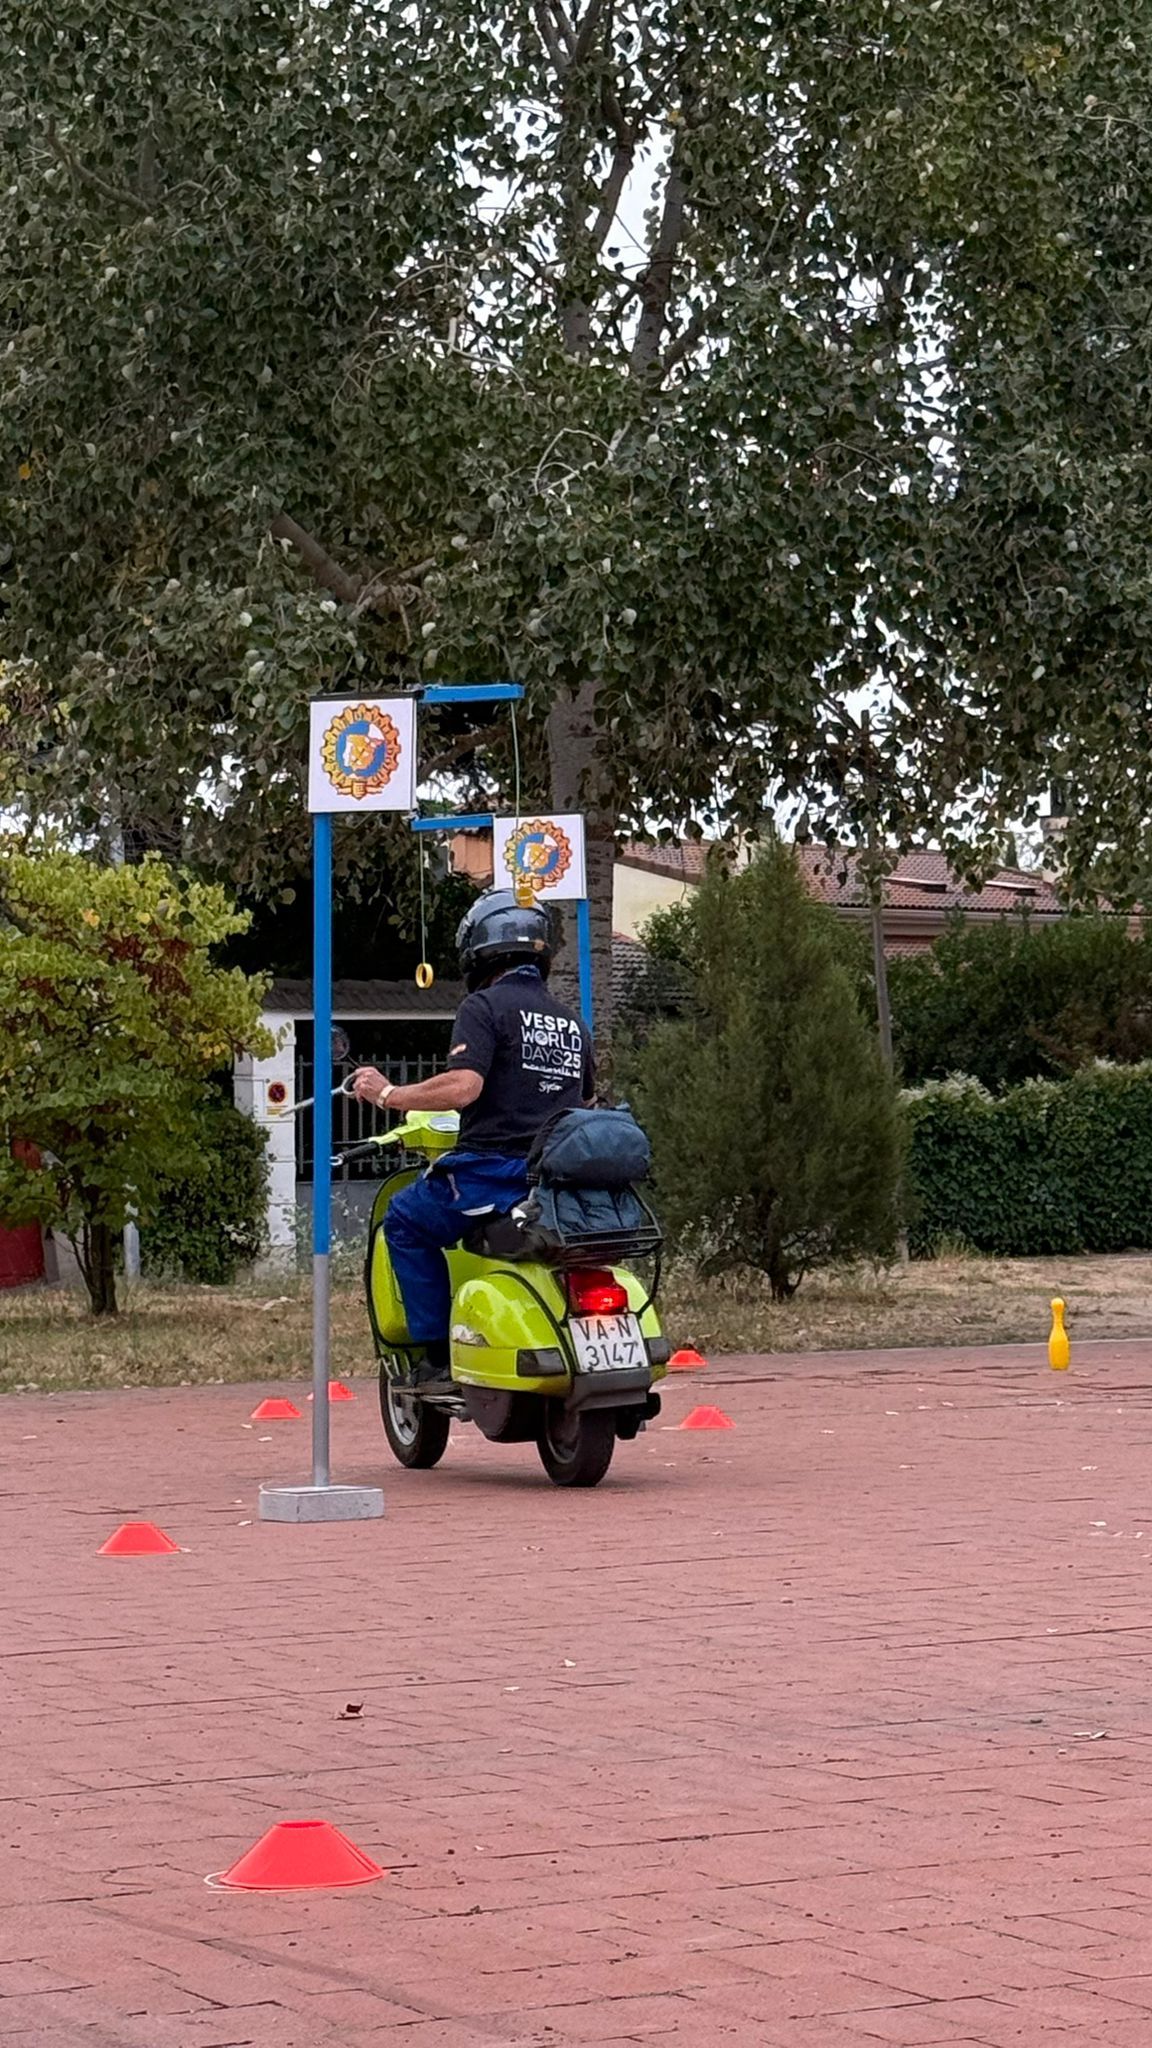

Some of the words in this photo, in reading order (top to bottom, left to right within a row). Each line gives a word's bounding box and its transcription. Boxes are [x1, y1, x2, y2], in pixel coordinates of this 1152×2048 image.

[519, 1009, 581, 1035] VESPA
[521, 1025, 582, 1052] WORLD
[575, 1317, 632, 1341] VA-N
[585, 1341, 639, 1367] 3147
